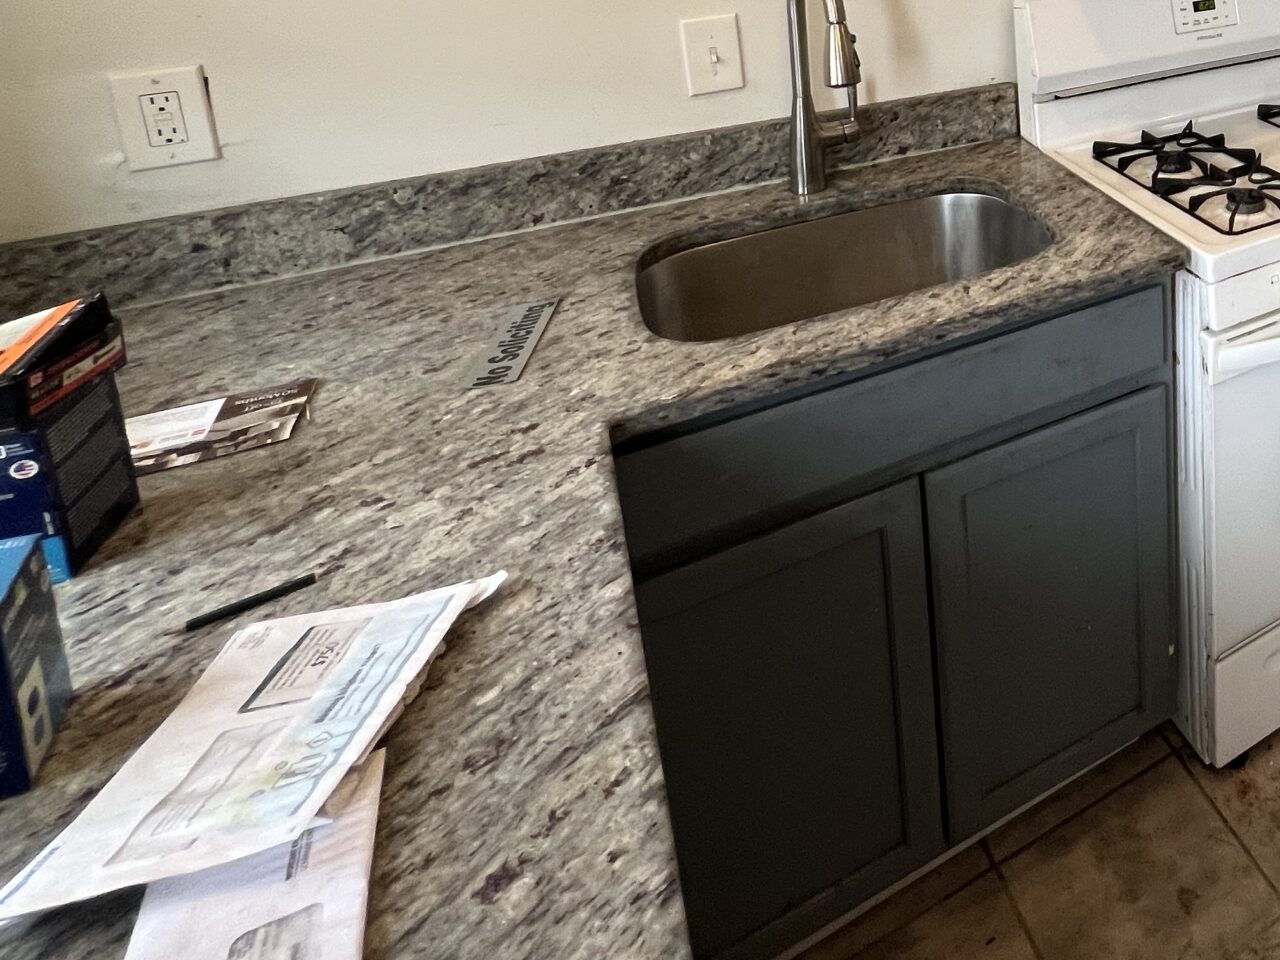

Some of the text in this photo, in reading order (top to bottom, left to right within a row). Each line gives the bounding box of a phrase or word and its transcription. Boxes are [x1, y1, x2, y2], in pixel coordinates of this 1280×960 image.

[472, 301, 555, 387] No Soliciting
[311, 641, 340, 667] $750
